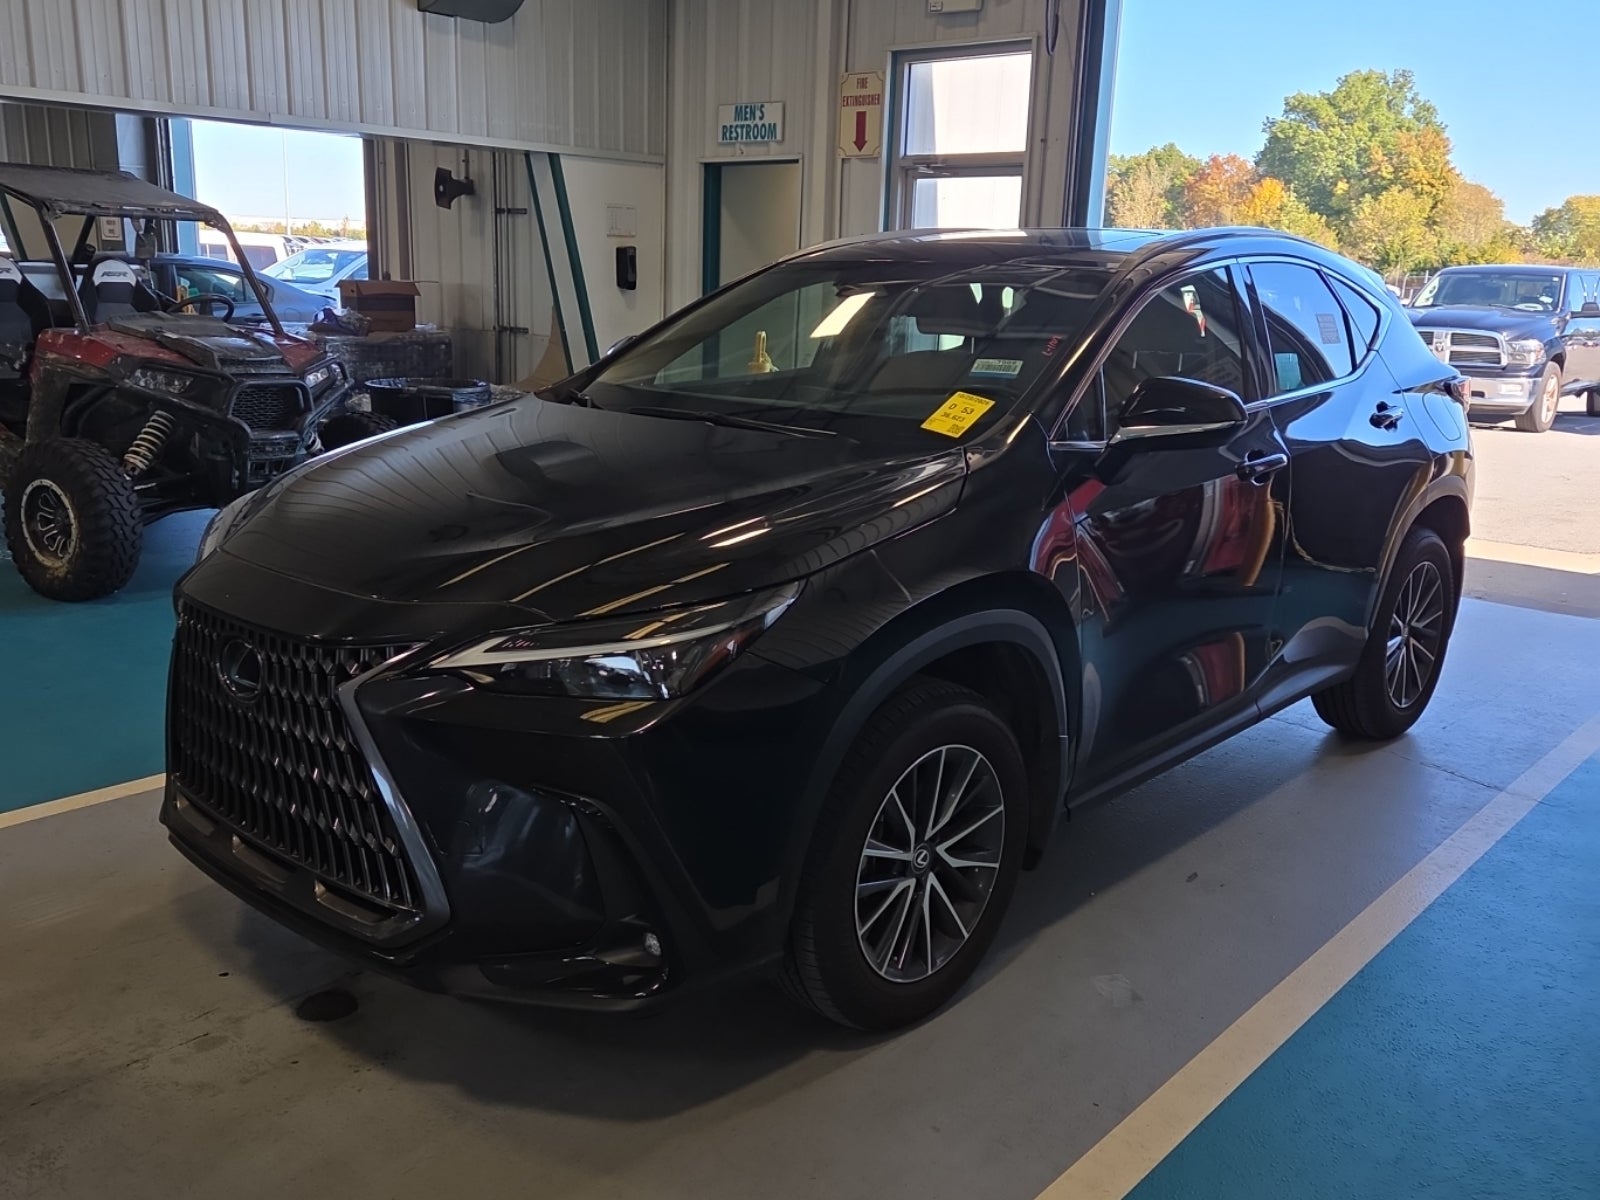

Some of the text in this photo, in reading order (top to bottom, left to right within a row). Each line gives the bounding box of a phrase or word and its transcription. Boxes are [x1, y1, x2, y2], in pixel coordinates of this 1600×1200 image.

[856, 77, 868, 90] FIRE
[842, 93, 881, 107] EXTINGUISHER
[734, 104, 766, 122] MEN'S
[722, 122, 777, 141] RESTROOM
[960, 406, 975, 415] 53
